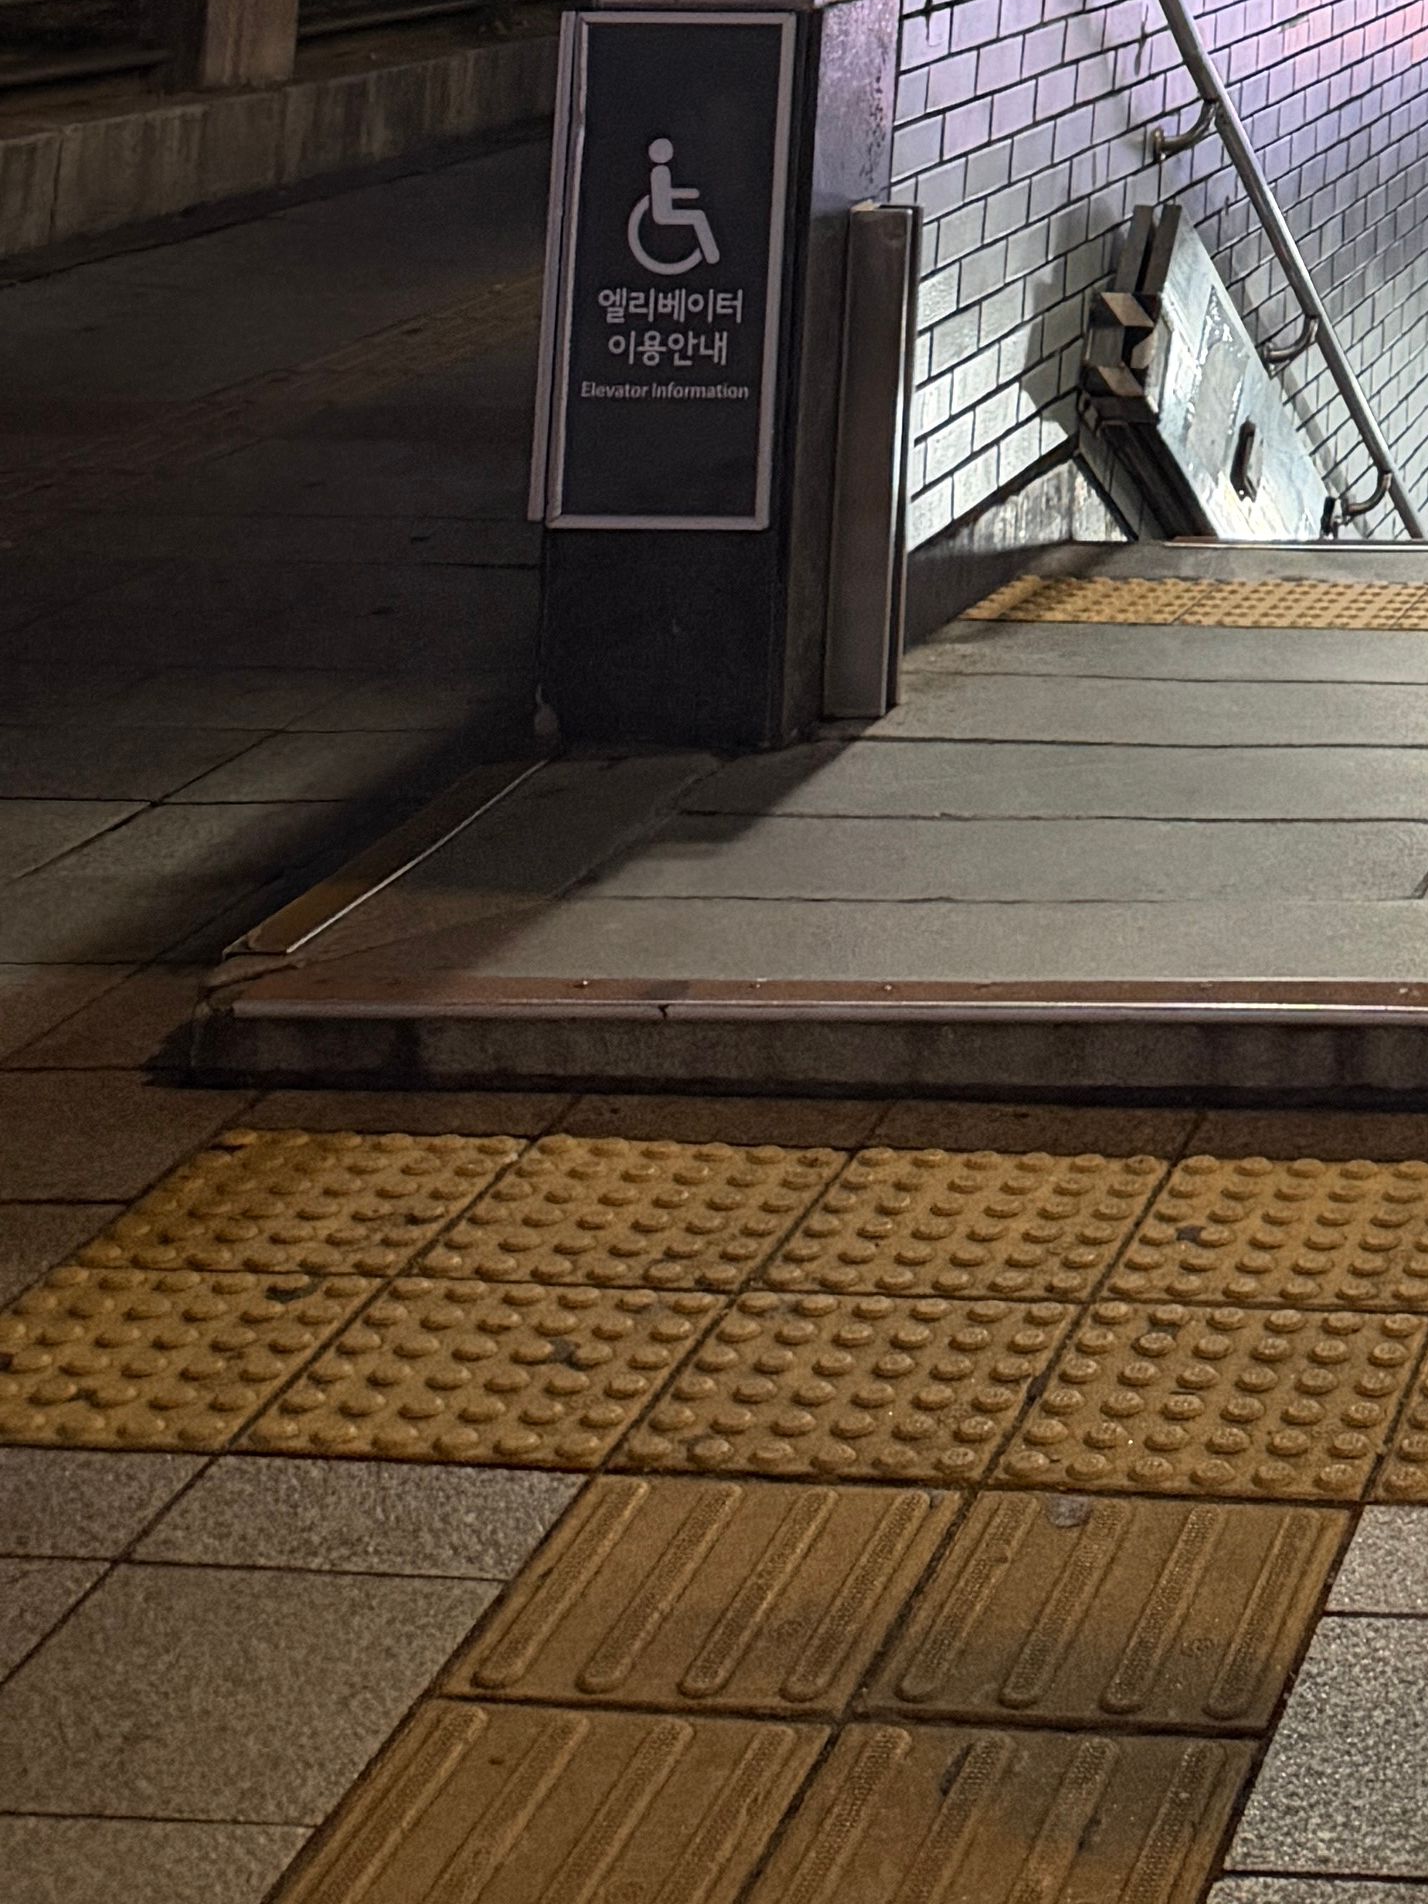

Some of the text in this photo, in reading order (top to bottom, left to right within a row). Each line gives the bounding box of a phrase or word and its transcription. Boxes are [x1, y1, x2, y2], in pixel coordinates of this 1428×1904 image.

[598, 287, 743, 324] 엘리베이터
[608, 330, 728, 367] 이용안내
[581, 380, 750, 400] Elevator Information
